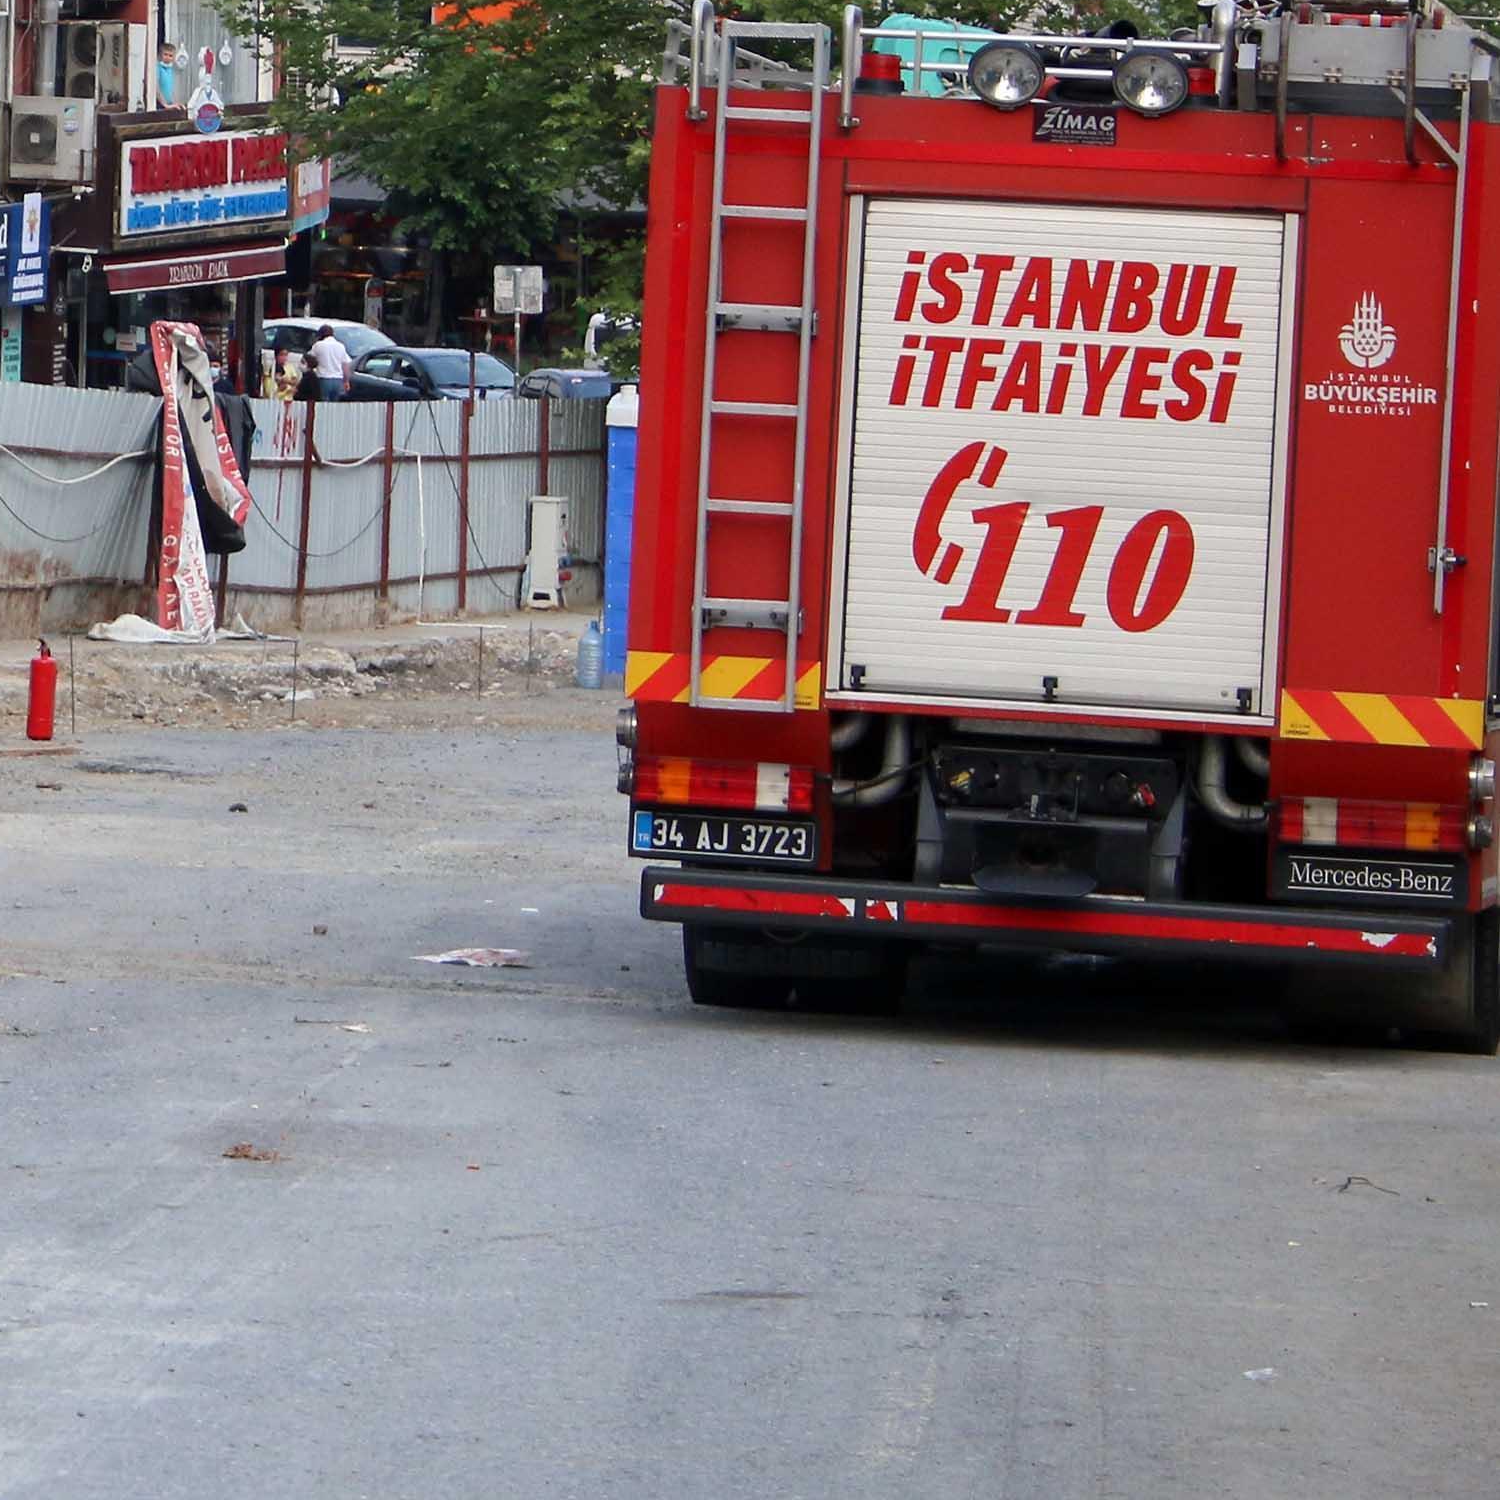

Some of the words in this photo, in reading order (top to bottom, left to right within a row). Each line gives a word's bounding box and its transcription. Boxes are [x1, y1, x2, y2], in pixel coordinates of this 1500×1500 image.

[894, 250, 1243, 337] İSTANBUL
[889, 336, 1242, 423] İTFAİYESİ
[1304, 380, 1438, 408] BÜYÜKŞEHİR
[941, 502, 1196, 633] 110
[652, 819, 684, 848] 34
[696, 821, 729, 850] AJ
[741, 824, 807, 856] 3723
[1288, 861, 1454, 894] Mercedes-Benz
